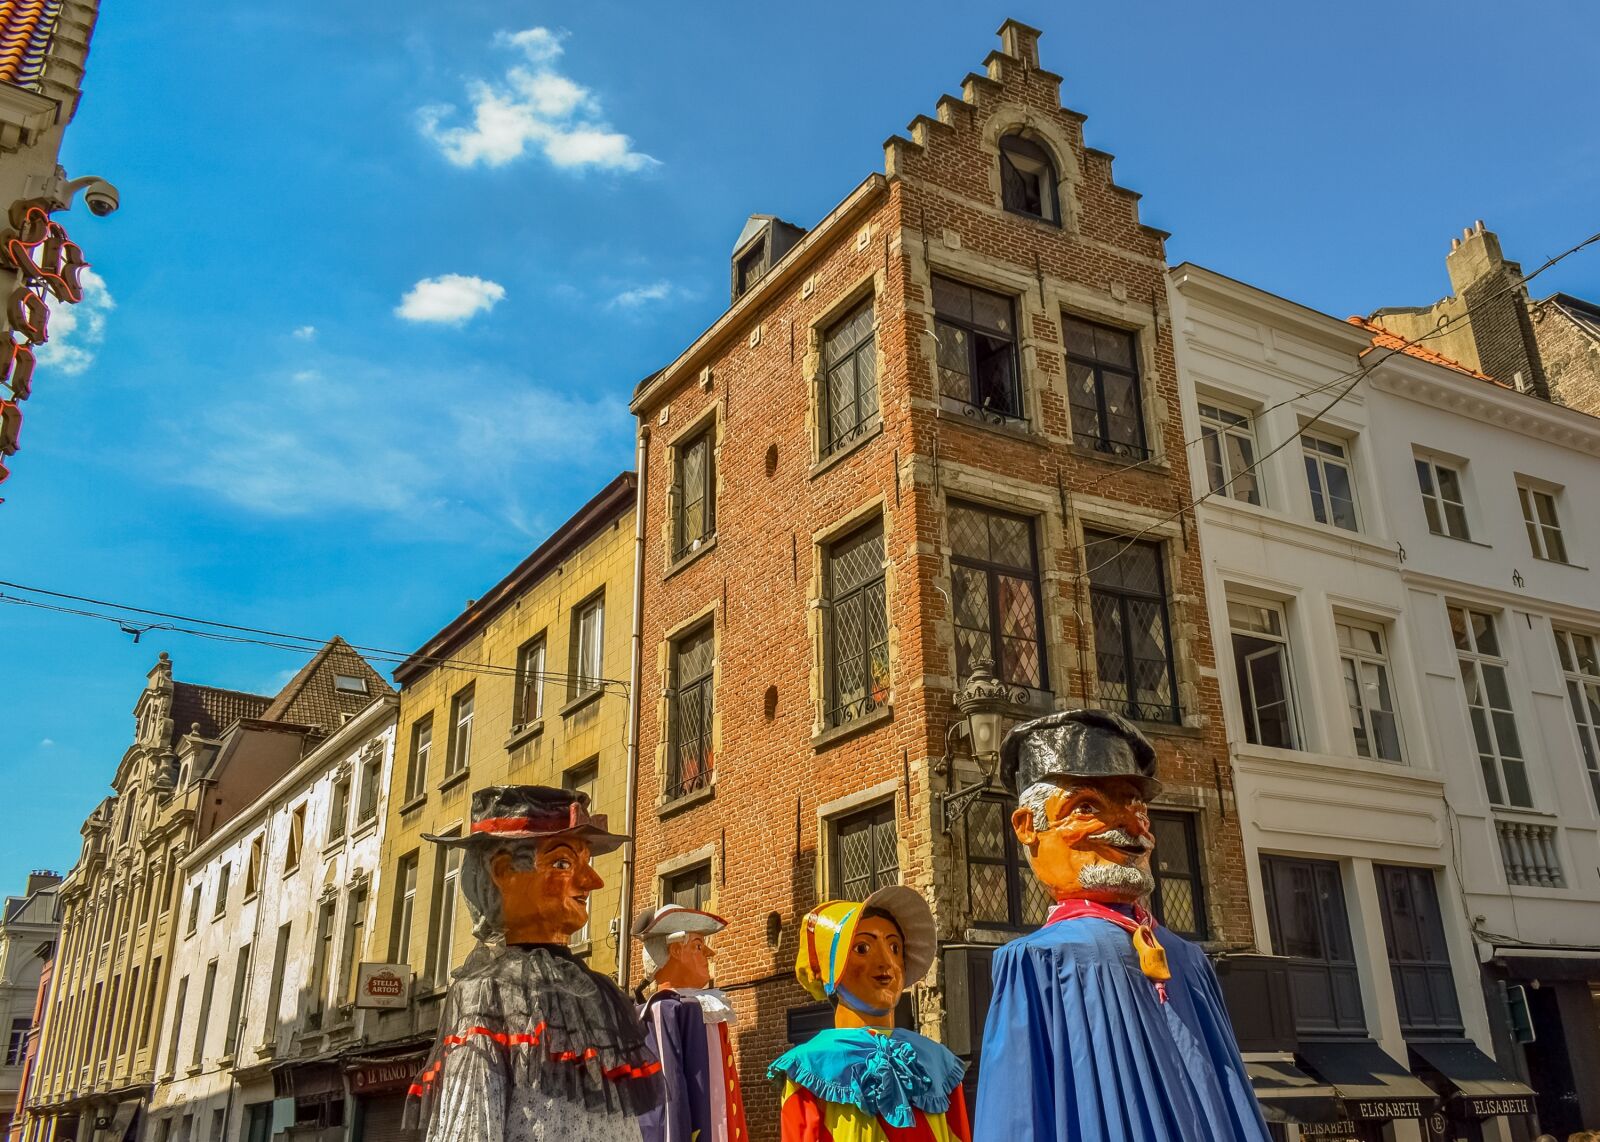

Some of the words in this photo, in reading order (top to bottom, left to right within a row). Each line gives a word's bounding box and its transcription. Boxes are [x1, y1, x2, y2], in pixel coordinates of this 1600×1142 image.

[372, 979, 399, 987] STELLA
[371, 986, 399, 994] ARTOIS
[368, 1068, 377, 1084] LE
[379, 1063, 407, 1083] FRANCO
